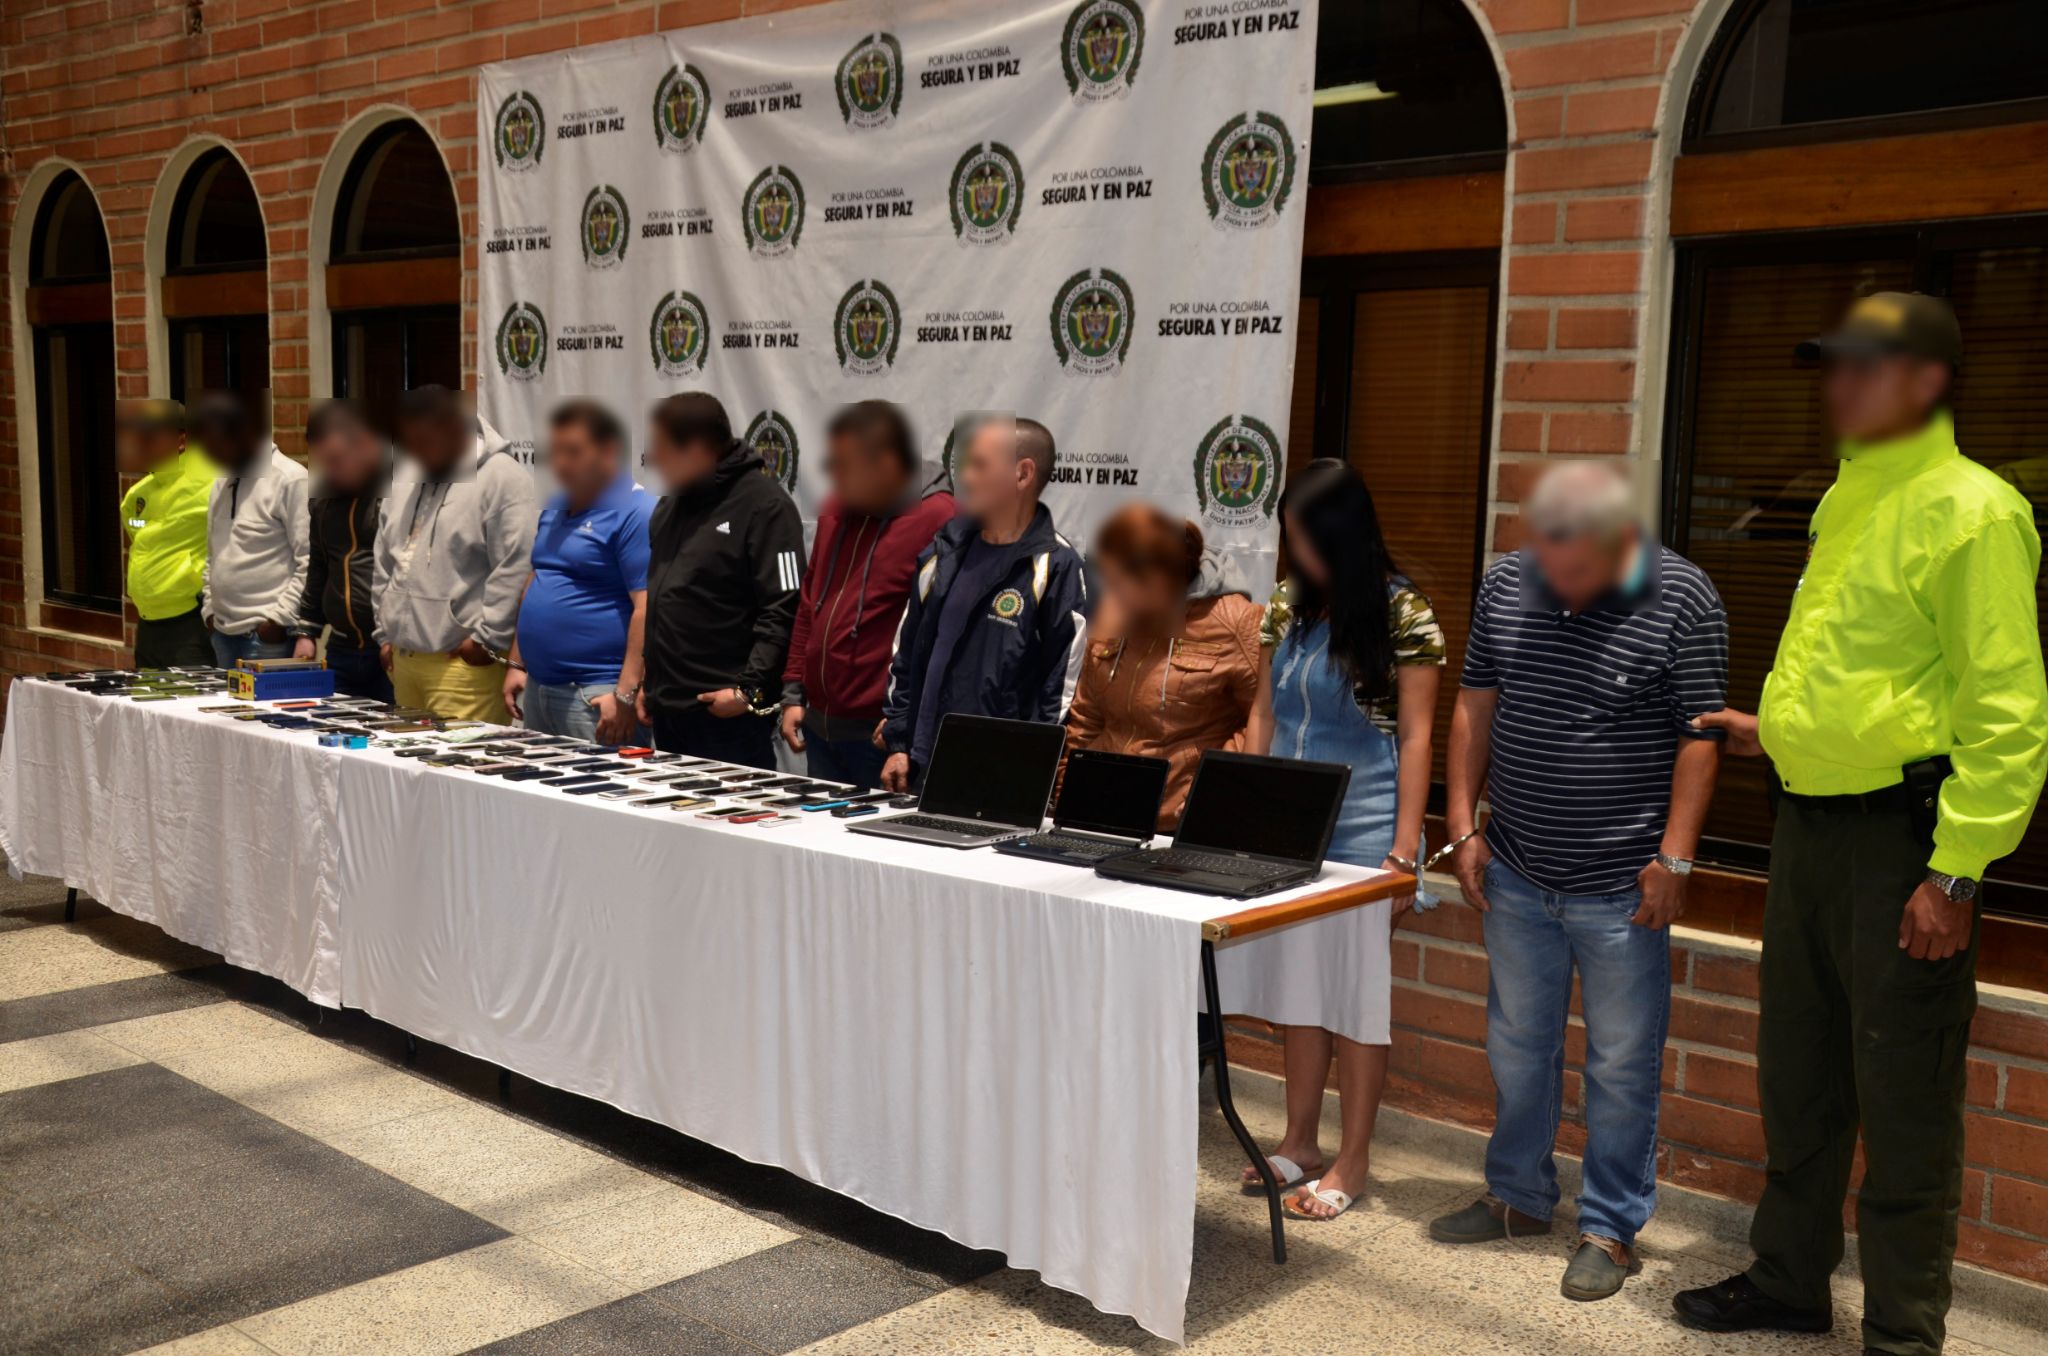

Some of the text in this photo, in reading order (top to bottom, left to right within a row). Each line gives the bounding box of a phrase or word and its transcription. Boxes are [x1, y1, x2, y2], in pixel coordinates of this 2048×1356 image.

[1185, 7, 1202, 19] POR
[1206, 5, 1229, 16] UNA
[1174, 11, 1299, 45] SEGURA Y EN PAZ
[928, 45, 1011, 66] POR UNA COLOMBIA
[921, 59, 1020, 88] SEGURA Y EN PAZ
[743, 87, 758, 96] UNA
[759, 82, 793, 94] COLOMBIA
[725, 93, 801, 118] SEGURA Y EN PAZ
[557, 123, 586, 139] SEGURA
[596, 120, 606, 133] EN
[609, 117, 624, 132] PAZ
[1052, 165, 1144, 183] POR UNA COLOMBIA
[832, 187, 904, 201] POR UNA COLOMBIA
[1042, 179, 1153, 205] SEGURA Y EN PAZ
[660, 210, 675, 219] UNA
[824, 200, 913, 222] SEGURA Y EN PAZ
[642, 222, 673, 238] SEGURA
[677, 222, 684, 235] Y
[687, 221, 698, 235] EN
[517, 239, 522, 251] Y
[526, 238, 536, 250] EN
[1170, 300, 1270, 314] POR UNA COLOMBIA
[925, 310, 1005, 322] POR UNA COLOMBIA
[740, 321, 753, 329] UNA
[754, 320, 792, 329] COLOMBIA
[1158, 315, 1282, 336] SEGURA Y EN PAZ
[722, 333, 799, 349] SEGURA Y EN PAZ
[917, 324, 1012, 342] SEGURA Y EN PAZ
[557, 337, 587, 350] SEGURA
[594, 336, 603, 349] EN
[606, 335, 623, 349] PAZ
[511, 441, 521, 449] NA
[1065, 453, 1084, 463] UNA
[1086, 453, 1129, 464] COLOMBIA
[1050, 467, 1138, 485] GURA Y EN PAZ
